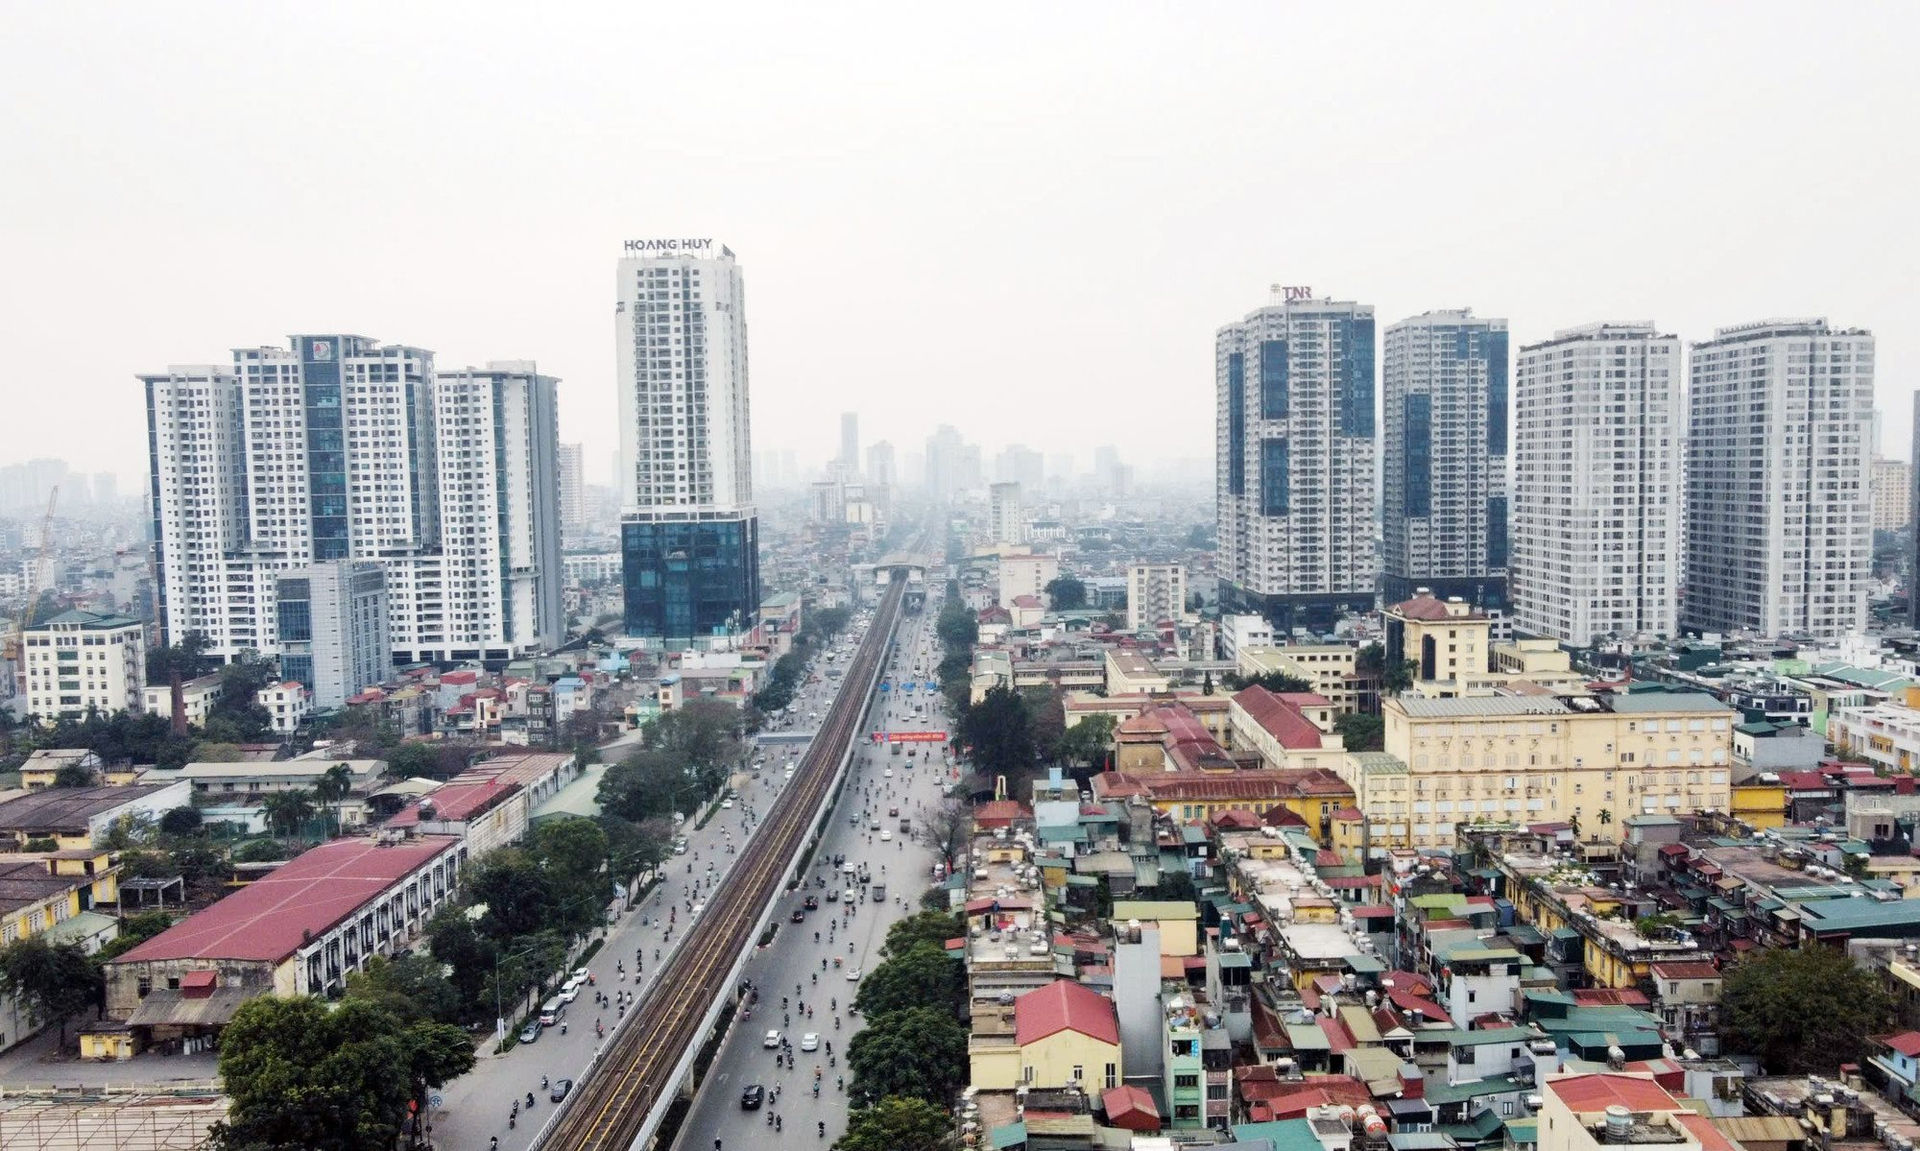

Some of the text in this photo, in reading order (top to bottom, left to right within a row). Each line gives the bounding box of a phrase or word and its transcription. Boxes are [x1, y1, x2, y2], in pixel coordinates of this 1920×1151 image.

[624, 238, 712, 250] HOANG HUY
[1282, 286, 1312, 299] TNR
